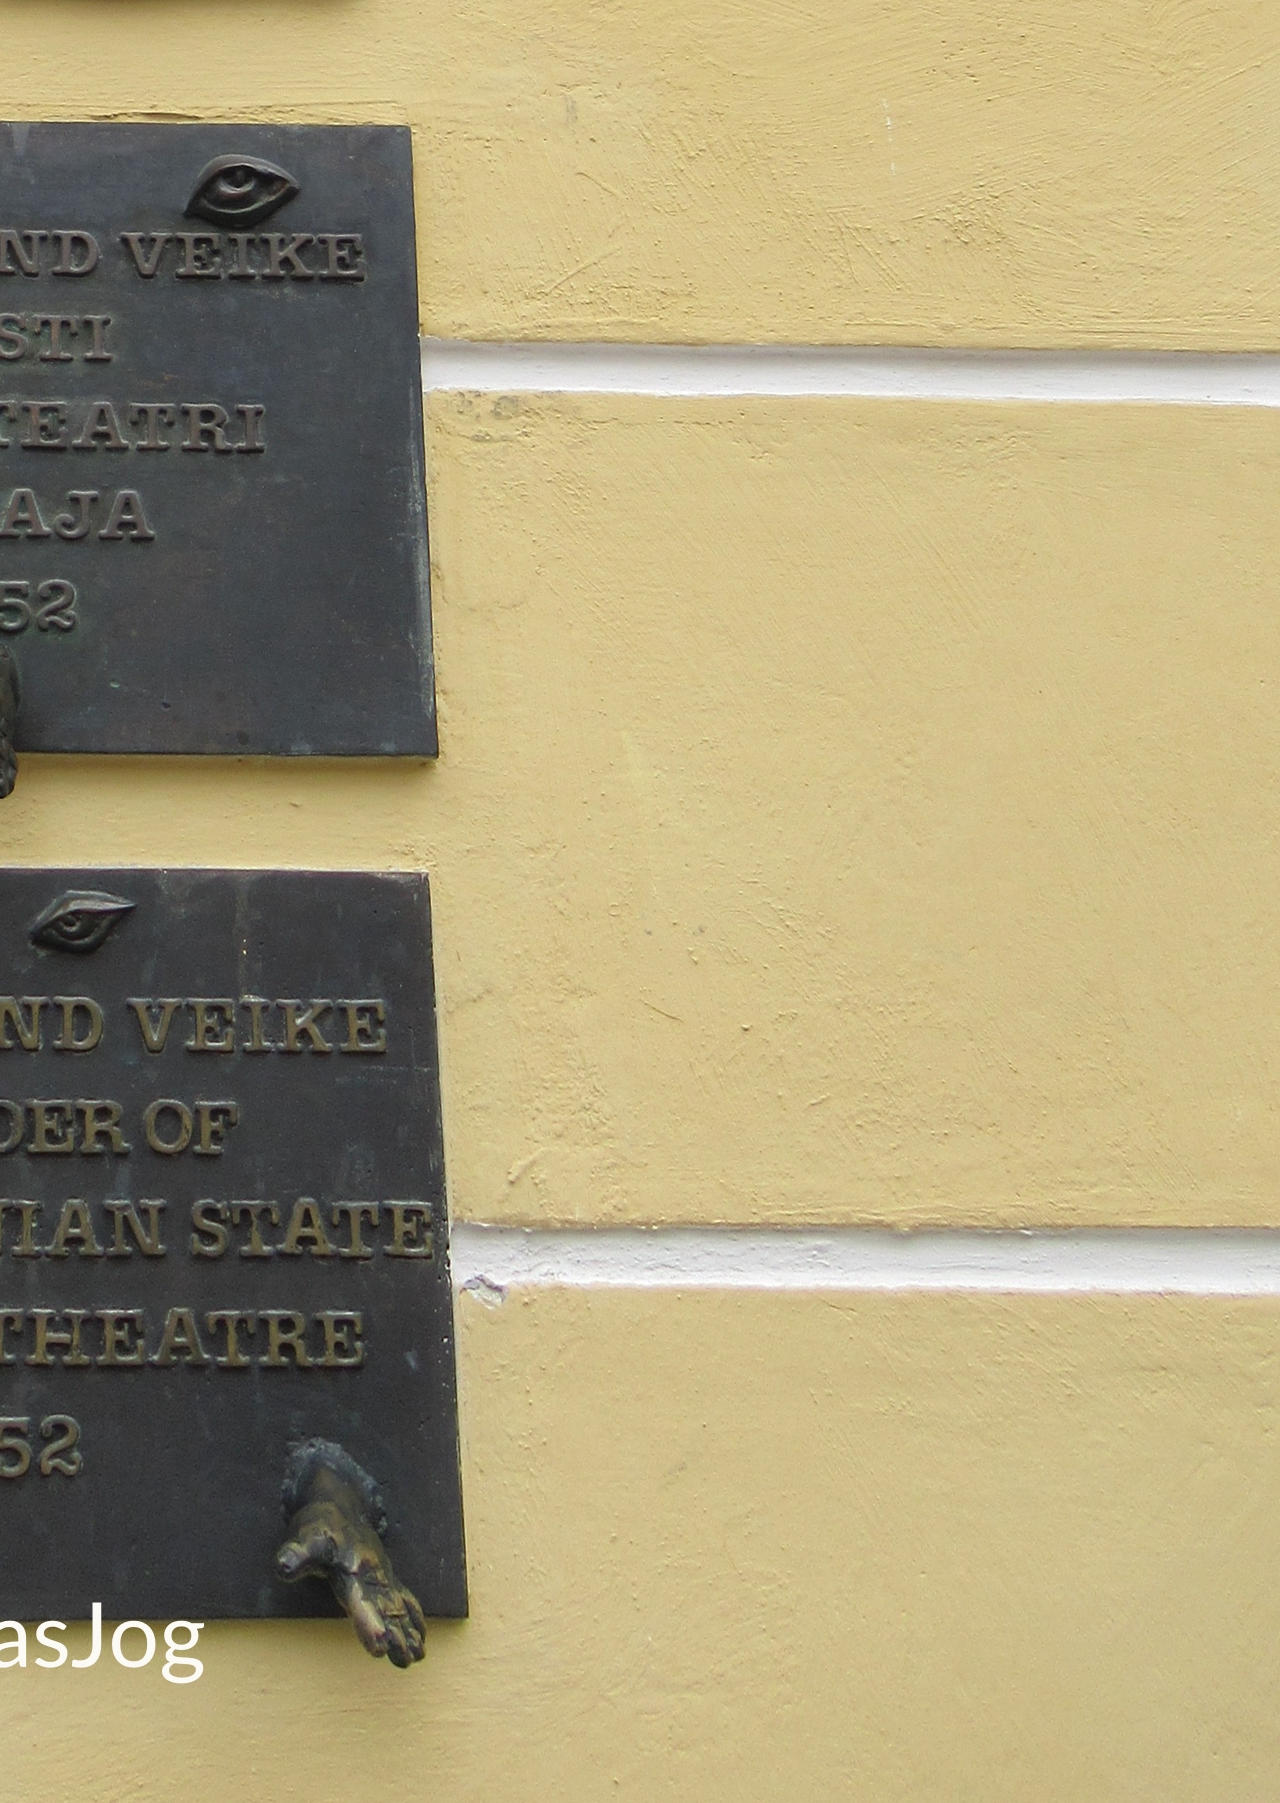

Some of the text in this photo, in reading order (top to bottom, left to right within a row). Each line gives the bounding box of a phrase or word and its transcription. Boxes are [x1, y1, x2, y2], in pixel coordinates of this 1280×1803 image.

[122, 232, 367, 281] VEIKE
[129, 998, 389, 1054] VEIKE
[145, 1100, 239, 1155] OF
[191, 1199, 435, 1260] STATE
